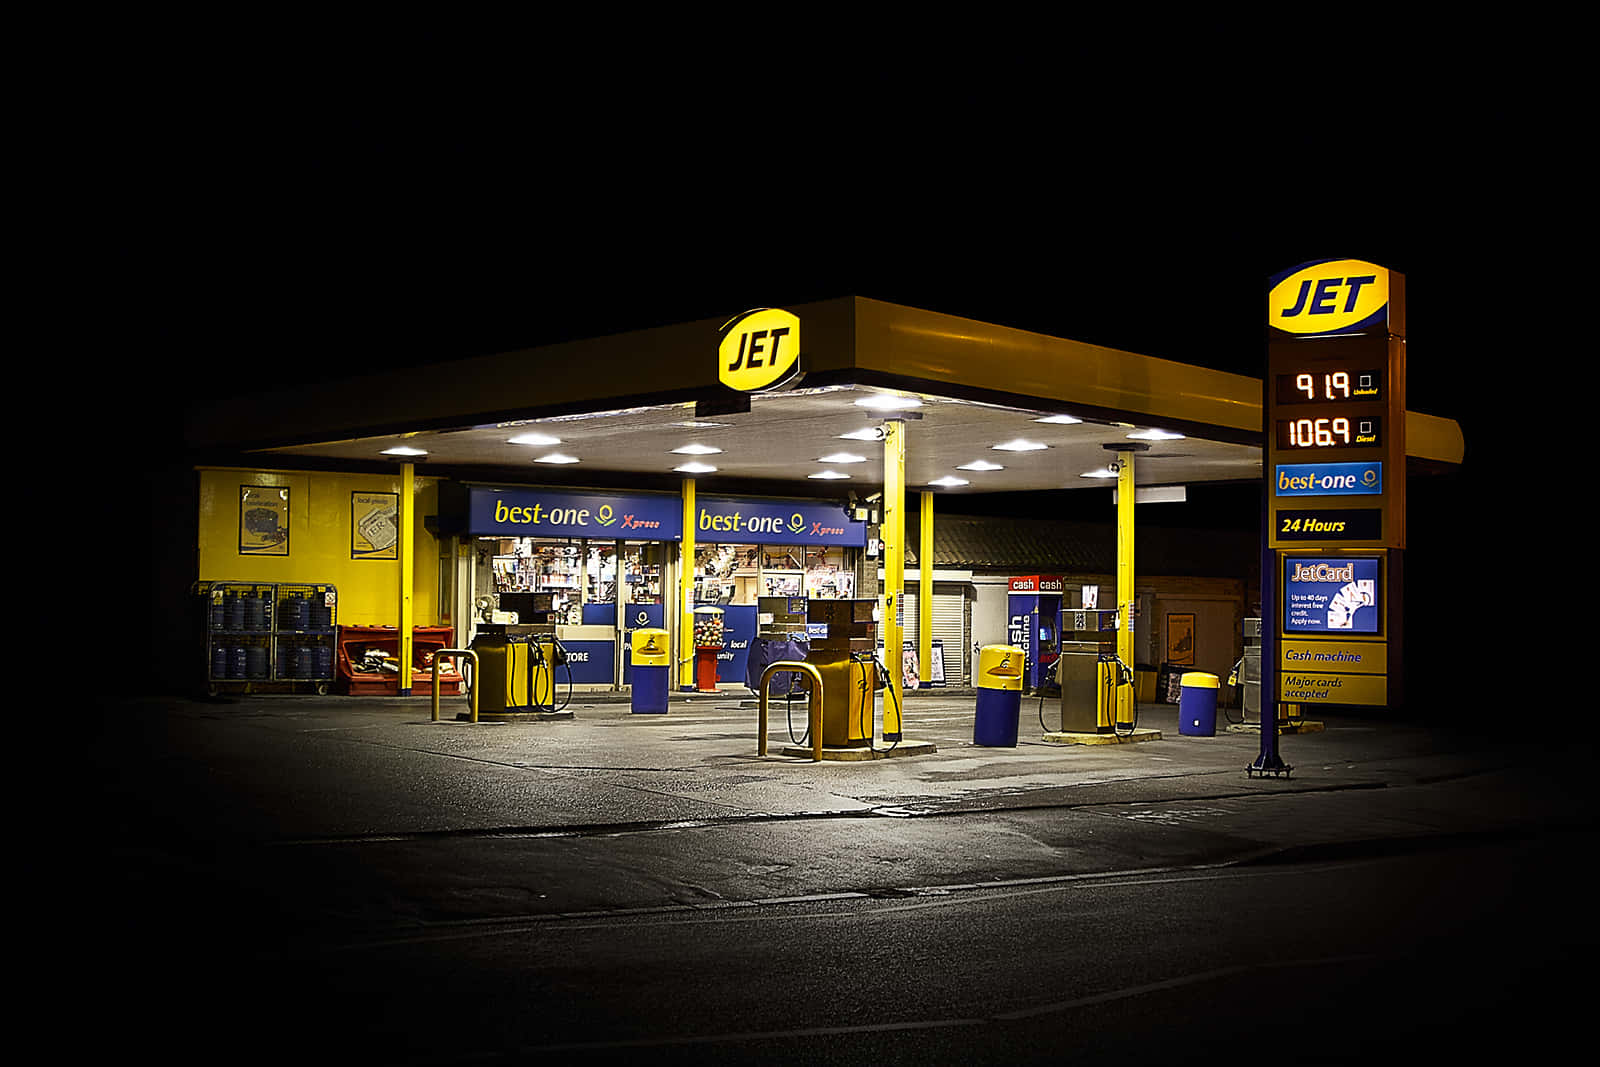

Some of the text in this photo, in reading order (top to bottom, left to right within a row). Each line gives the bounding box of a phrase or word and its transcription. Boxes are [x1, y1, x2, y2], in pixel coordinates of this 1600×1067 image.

[1281, 275, 1376, 318] JET
[728, 327, 790, 372] JET
[1289, 417, 1350, 447] 106.9
[1356, 435, 1376, 443] Diesel
[1279, 471, 1356, 490] best-one
[495, 500, 660, 529] best-one Xpress
[699, 508, 844, 536] best-one Xpress
[1281, 518, 1346, 532] 24 Hours
[1291, 563, 1354, 582] JetCard
[1013, 579, 1034, 590] cash
[1040, 579, 1062, 590] cash
[1315, 594, 1328, 602] days
[731, 640, 748, 648] local
[566, 652, 589, 662] TORE
[717, 651, 734, 662] unity
[1285, 649, 1362, 663] Cash machine
[1285, 676, 1344, 689] Major cards
[1284, 689, 1329, 700] accepted
